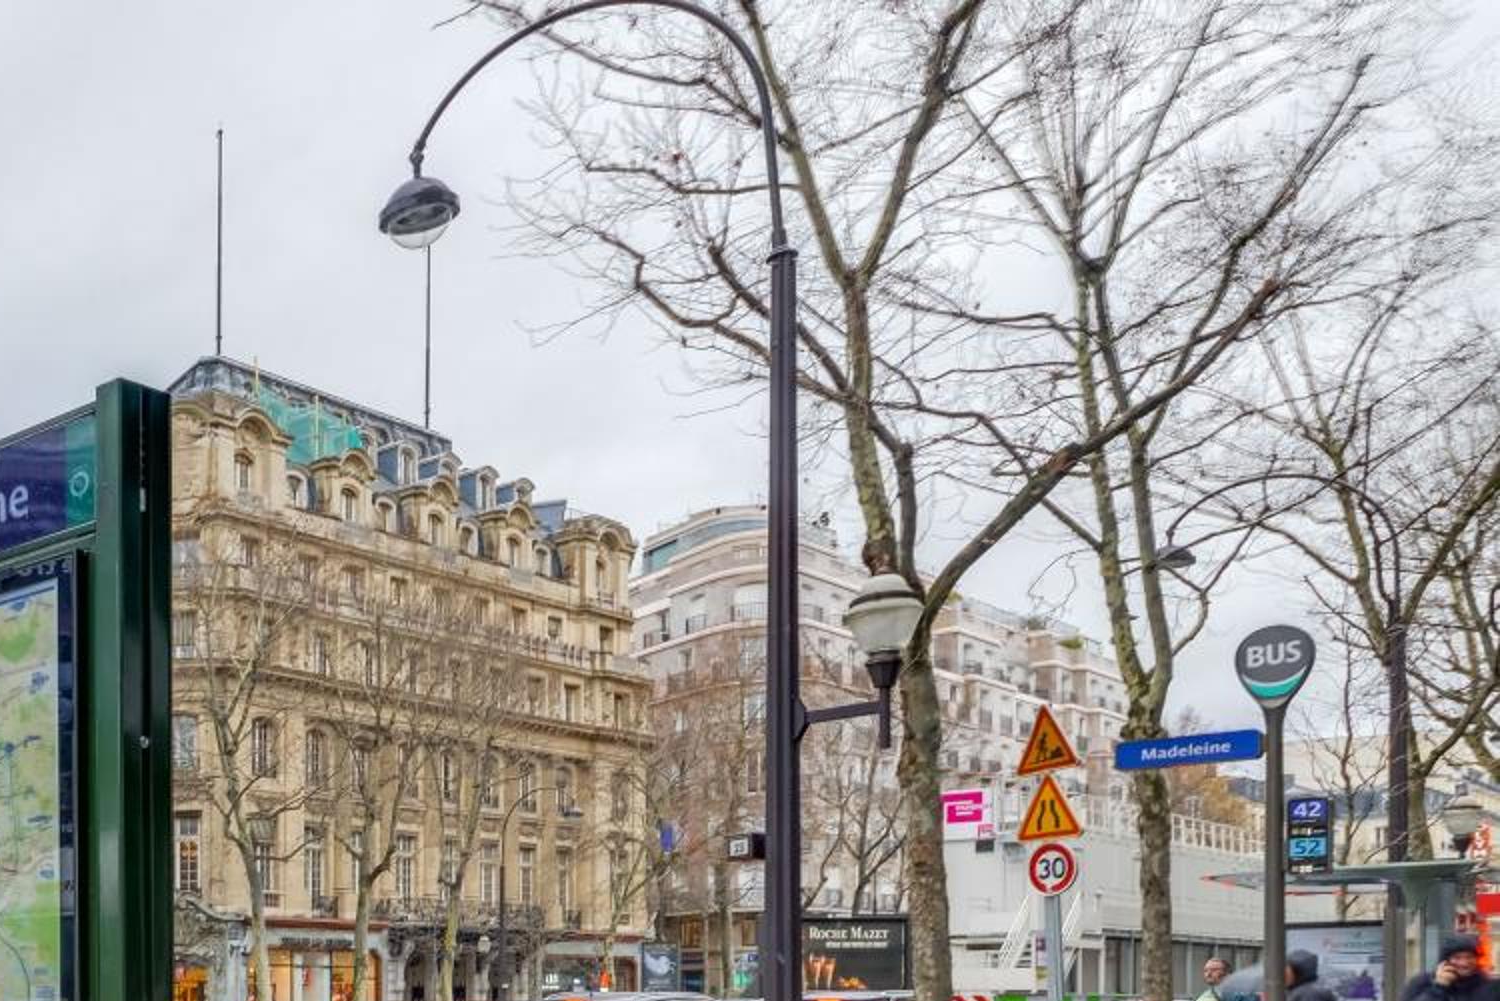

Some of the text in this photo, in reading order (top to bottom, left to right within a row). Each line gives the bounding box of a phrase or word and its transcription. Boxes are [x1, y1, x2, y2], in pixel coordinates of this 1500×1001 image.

[1246, 640, 1303, 668] BUS
[1141, 740, 1232, 761] Madeleine
[1293, 801, 1322, 817] 42
[1295, 839, 1321, 856] 52
[1038, 856, 1066, 880] 30
